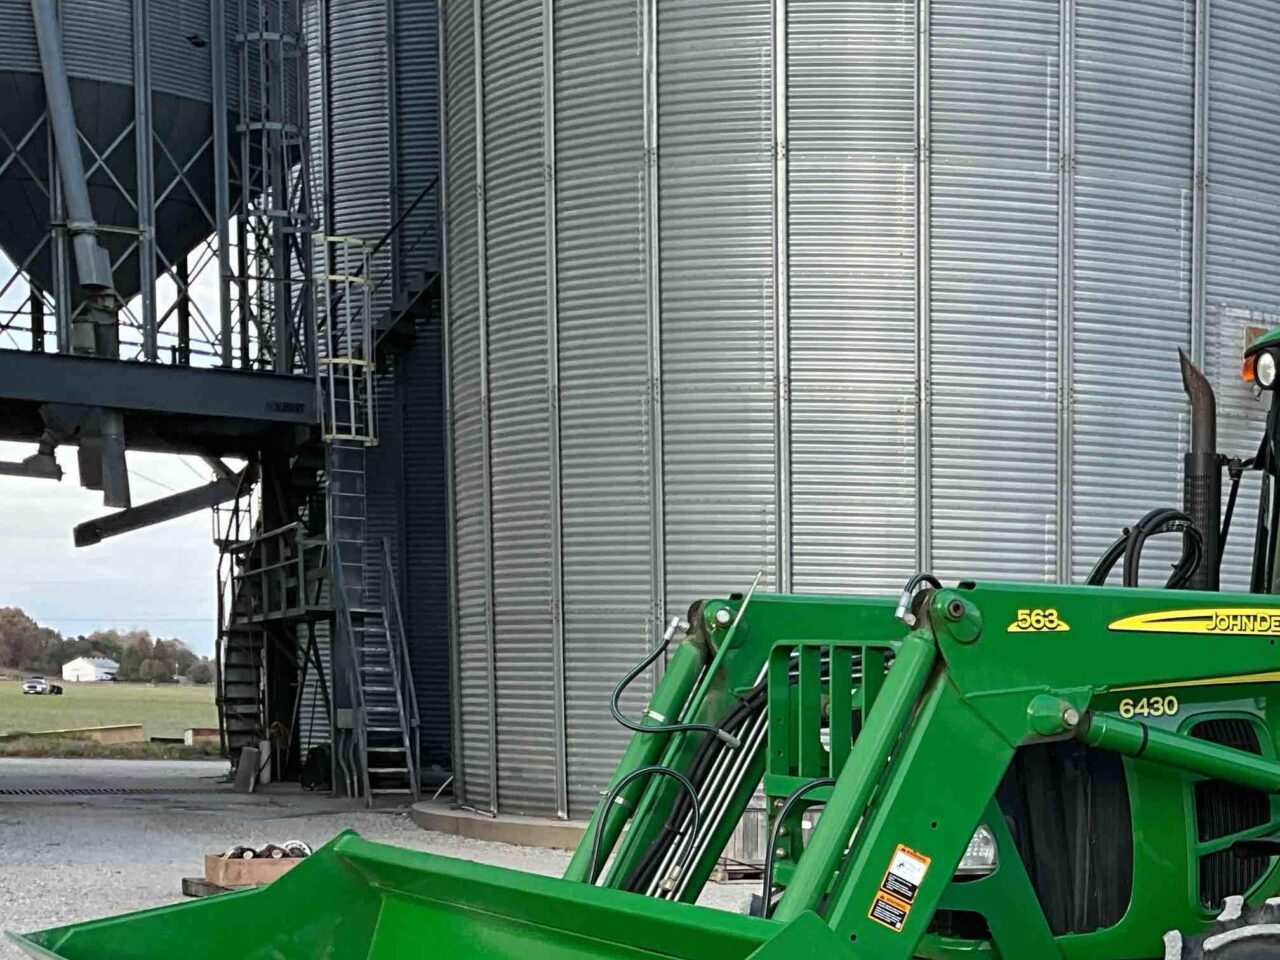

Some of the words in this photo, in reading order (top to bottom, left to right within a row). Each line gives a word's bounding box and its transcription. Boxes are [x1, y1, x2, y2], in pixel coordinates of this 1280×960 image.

[1017, 608, 1058, 629] 563
[1206, 611, 1256, 632] JOHN
[1119, 695, 1178, 719] 6430
